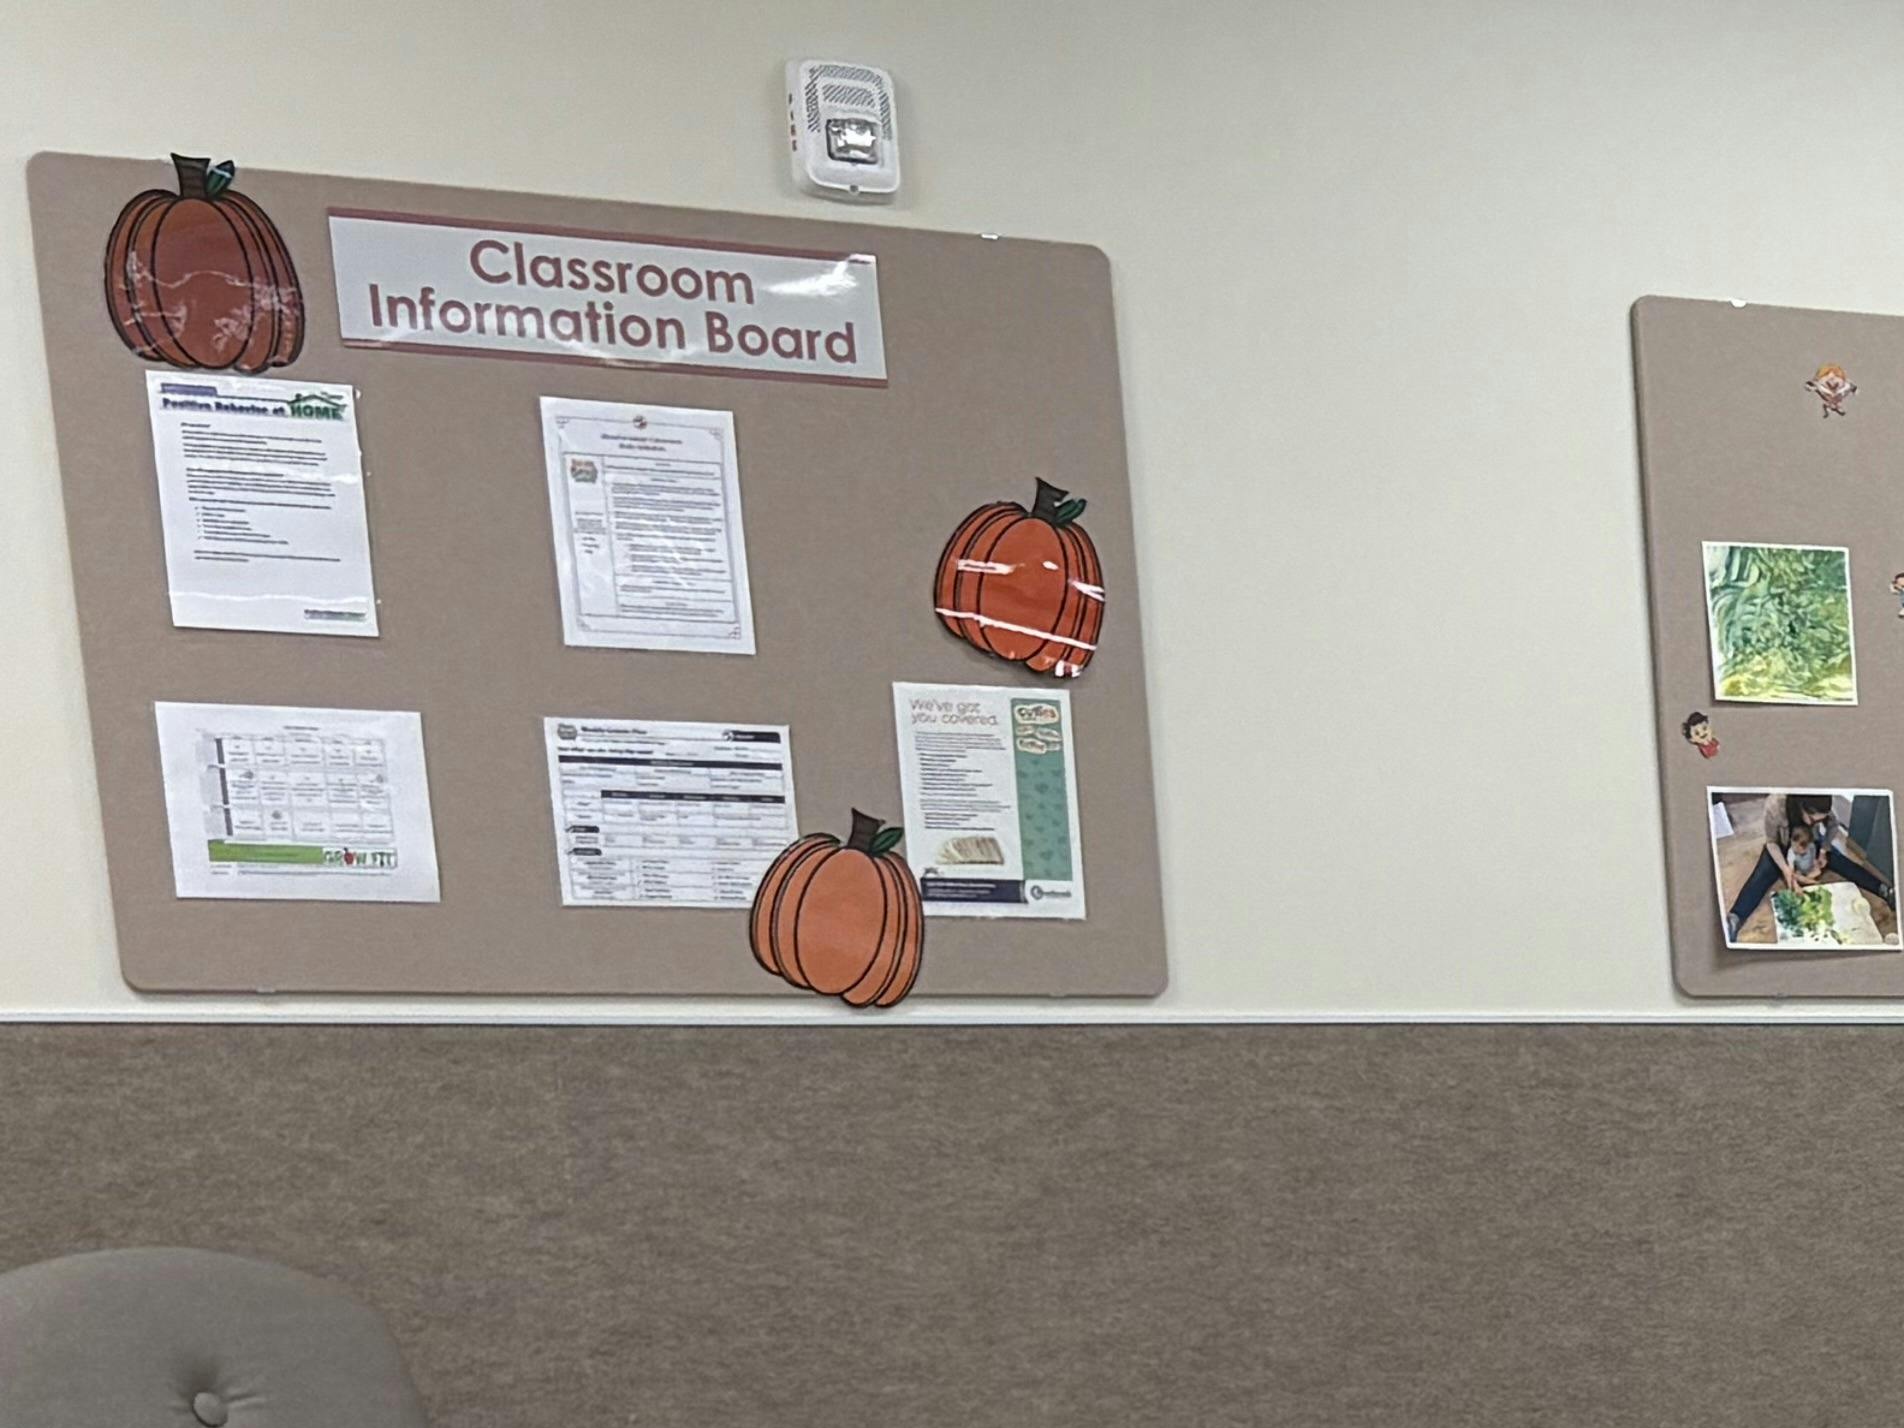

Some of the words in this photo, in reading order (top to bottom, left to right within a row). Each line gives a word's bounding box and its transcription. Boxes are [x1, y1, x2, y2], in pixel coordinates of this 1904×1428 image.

[469, 238, 755, 305] Classroom
[368, 283, 686, 350] Information
[704, 310, 857, 365] Board
[162, 397, 212, 412] Positive
[214, 401, 269, 415] Behavior
[272, 405, 286, 416] at
[290, 404, 344, 421] HOME
[909, 698, 954, 711] We've
[957, 702, 981, 714] got
[911, 712, 937, 725] you
